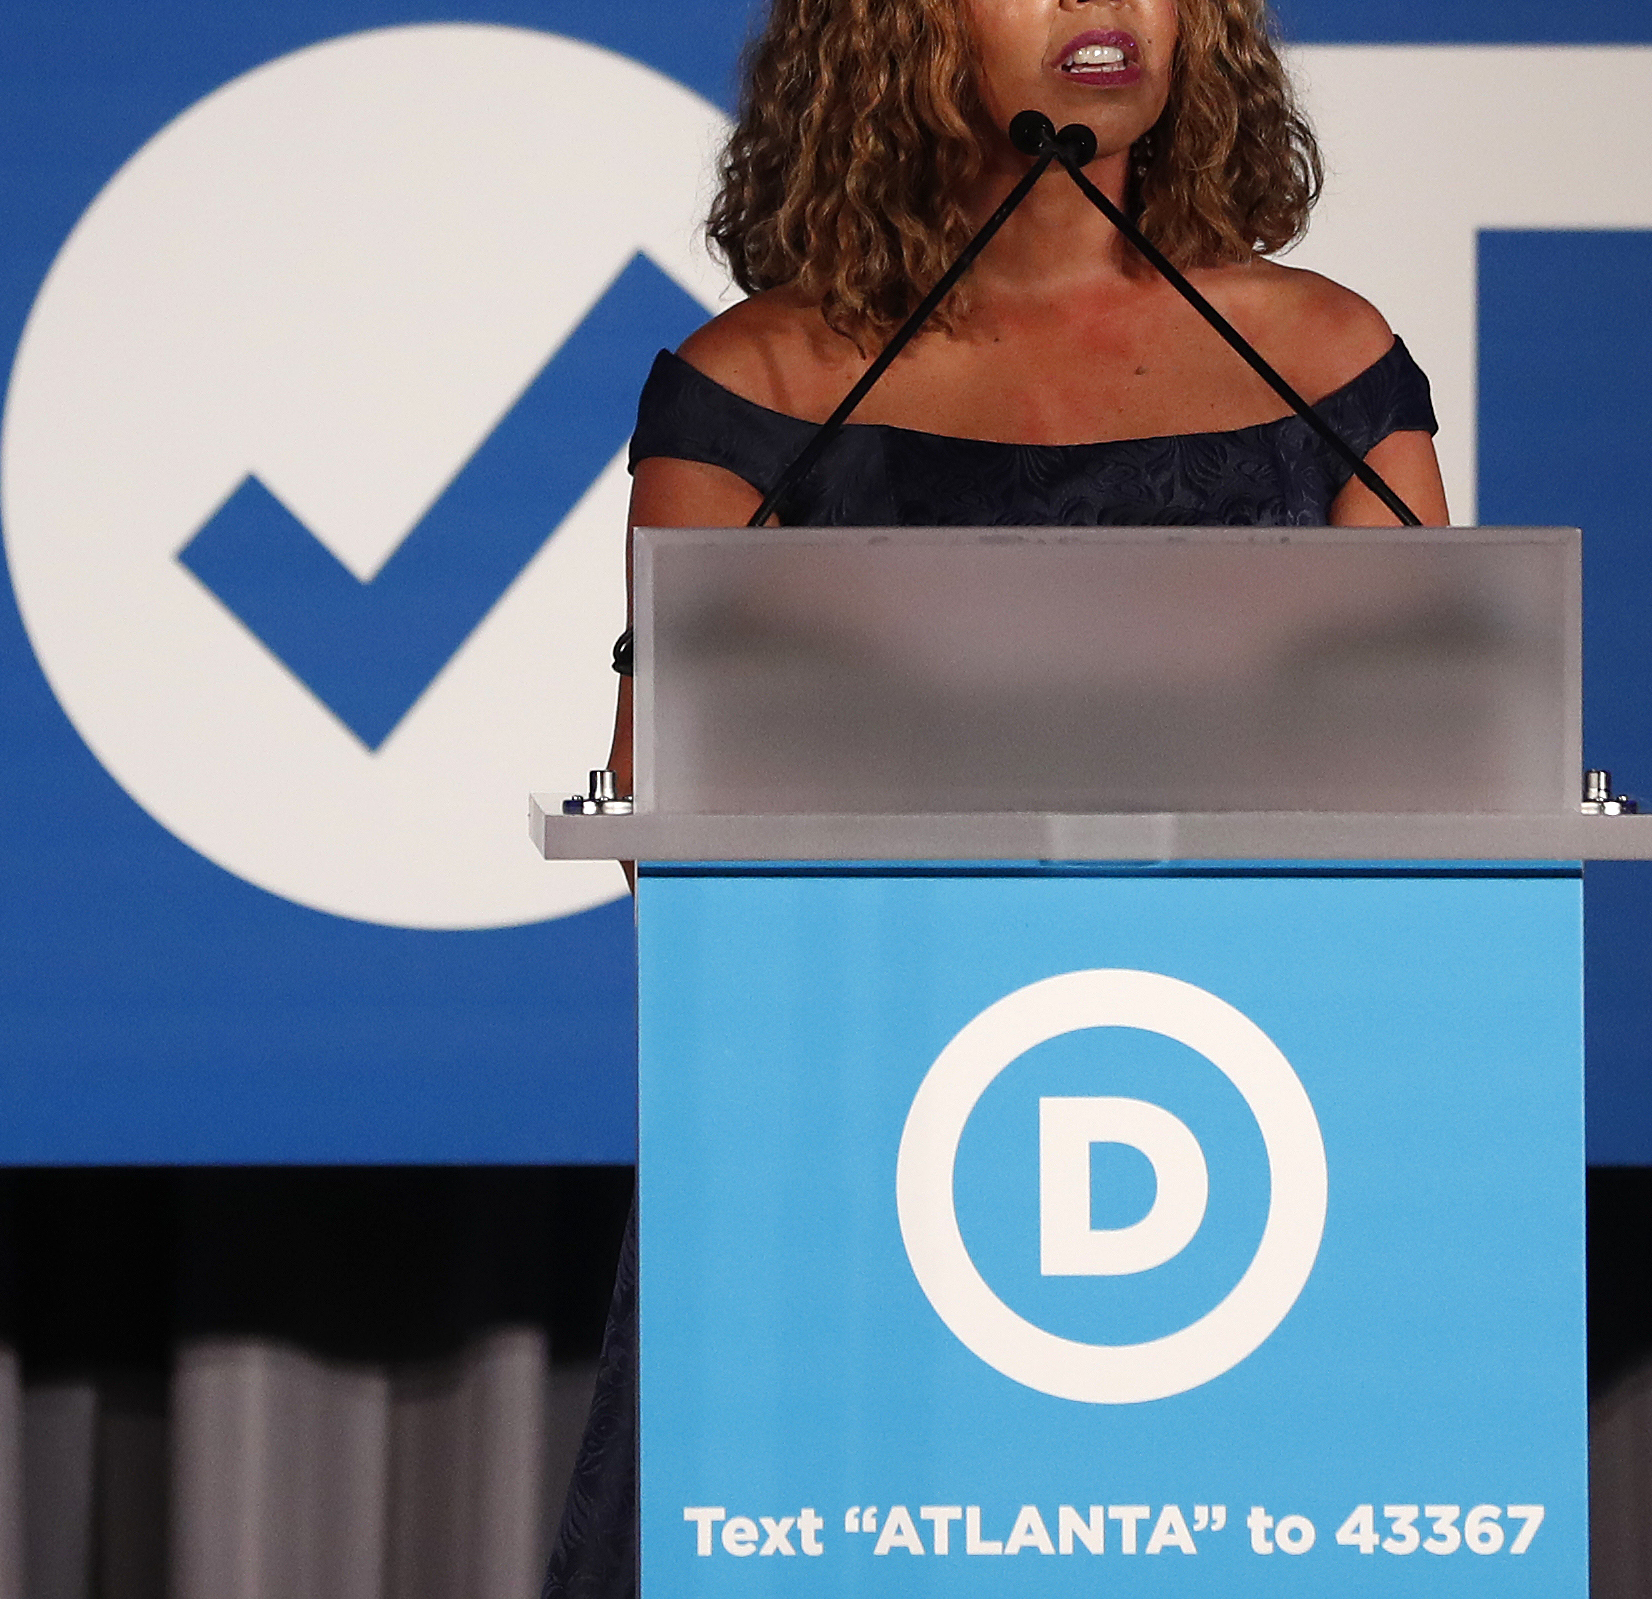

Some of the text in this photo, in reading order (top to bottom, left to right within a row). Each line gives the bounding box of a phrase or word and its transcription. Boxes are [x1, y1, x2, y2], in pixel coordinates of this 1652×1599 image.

[1038, 1095, 1209, 1277] D
[683, 1503, 1546, 1557] Text “ATLANTA” to 43367
